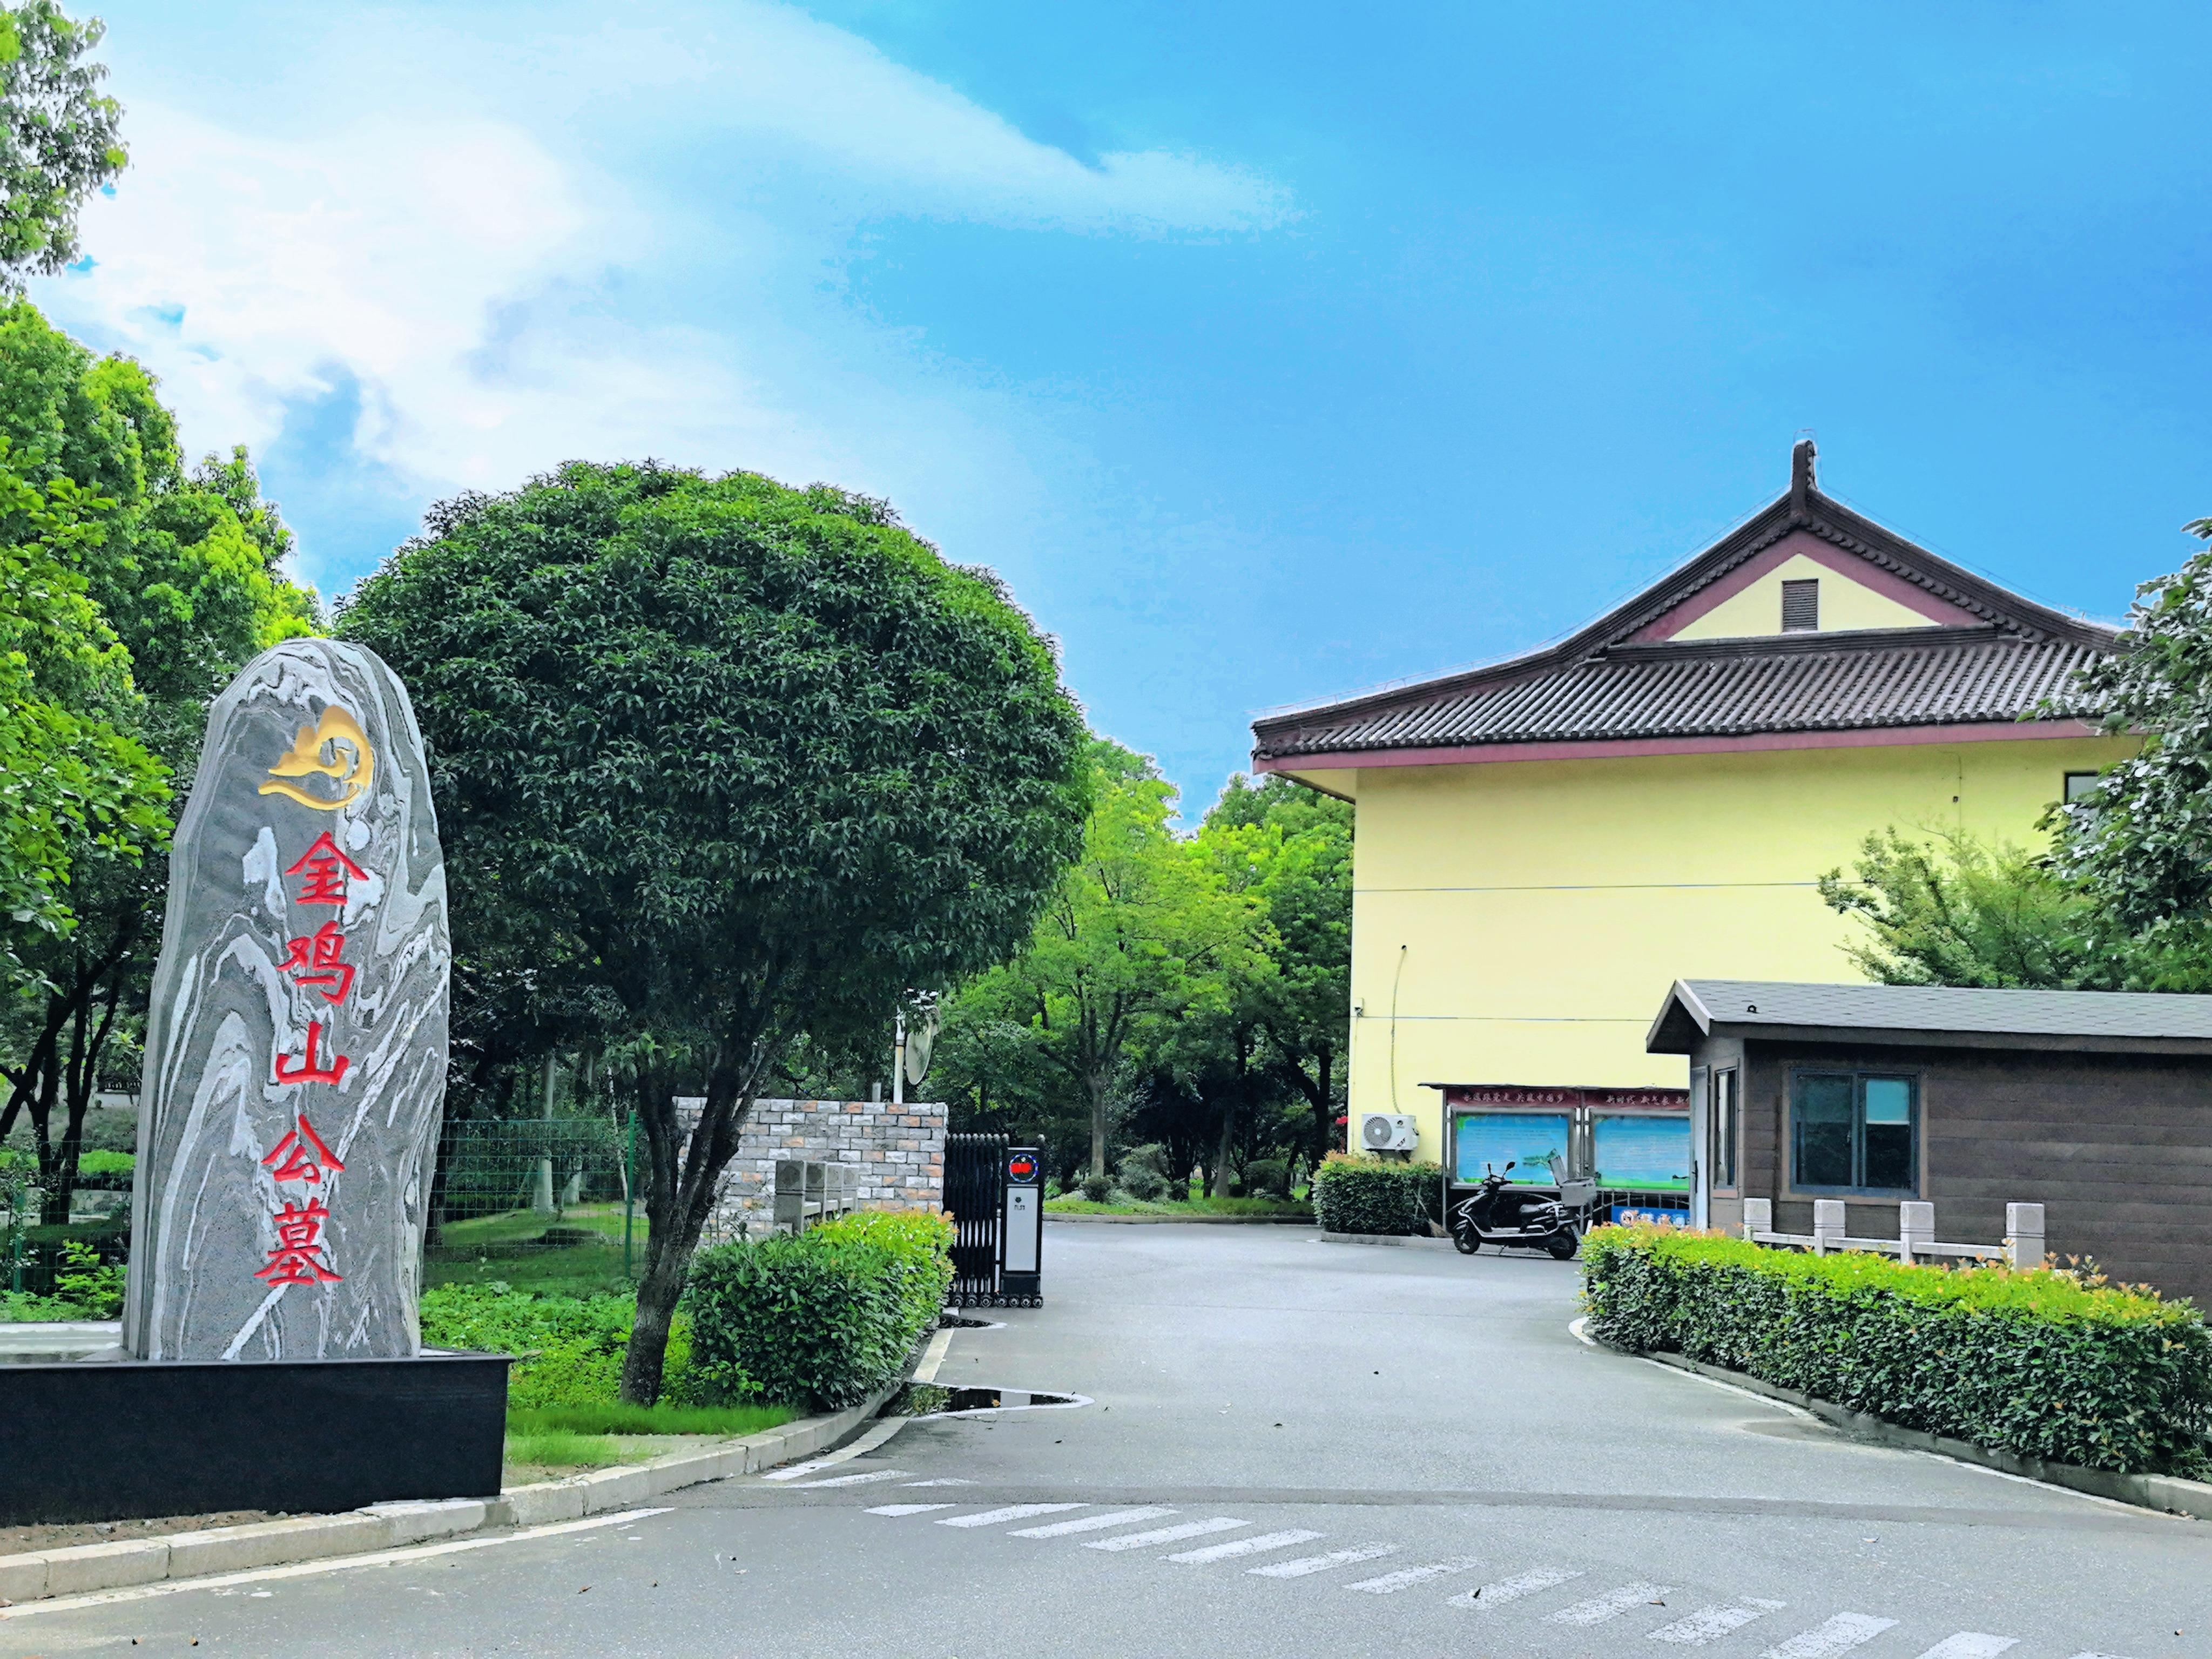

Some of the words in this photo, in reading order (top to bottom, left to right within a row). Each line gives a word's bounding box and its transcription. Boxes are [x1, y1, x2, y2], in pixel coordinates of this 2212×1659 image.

[254, 831, 369, 1287] 金鸡山公墓
